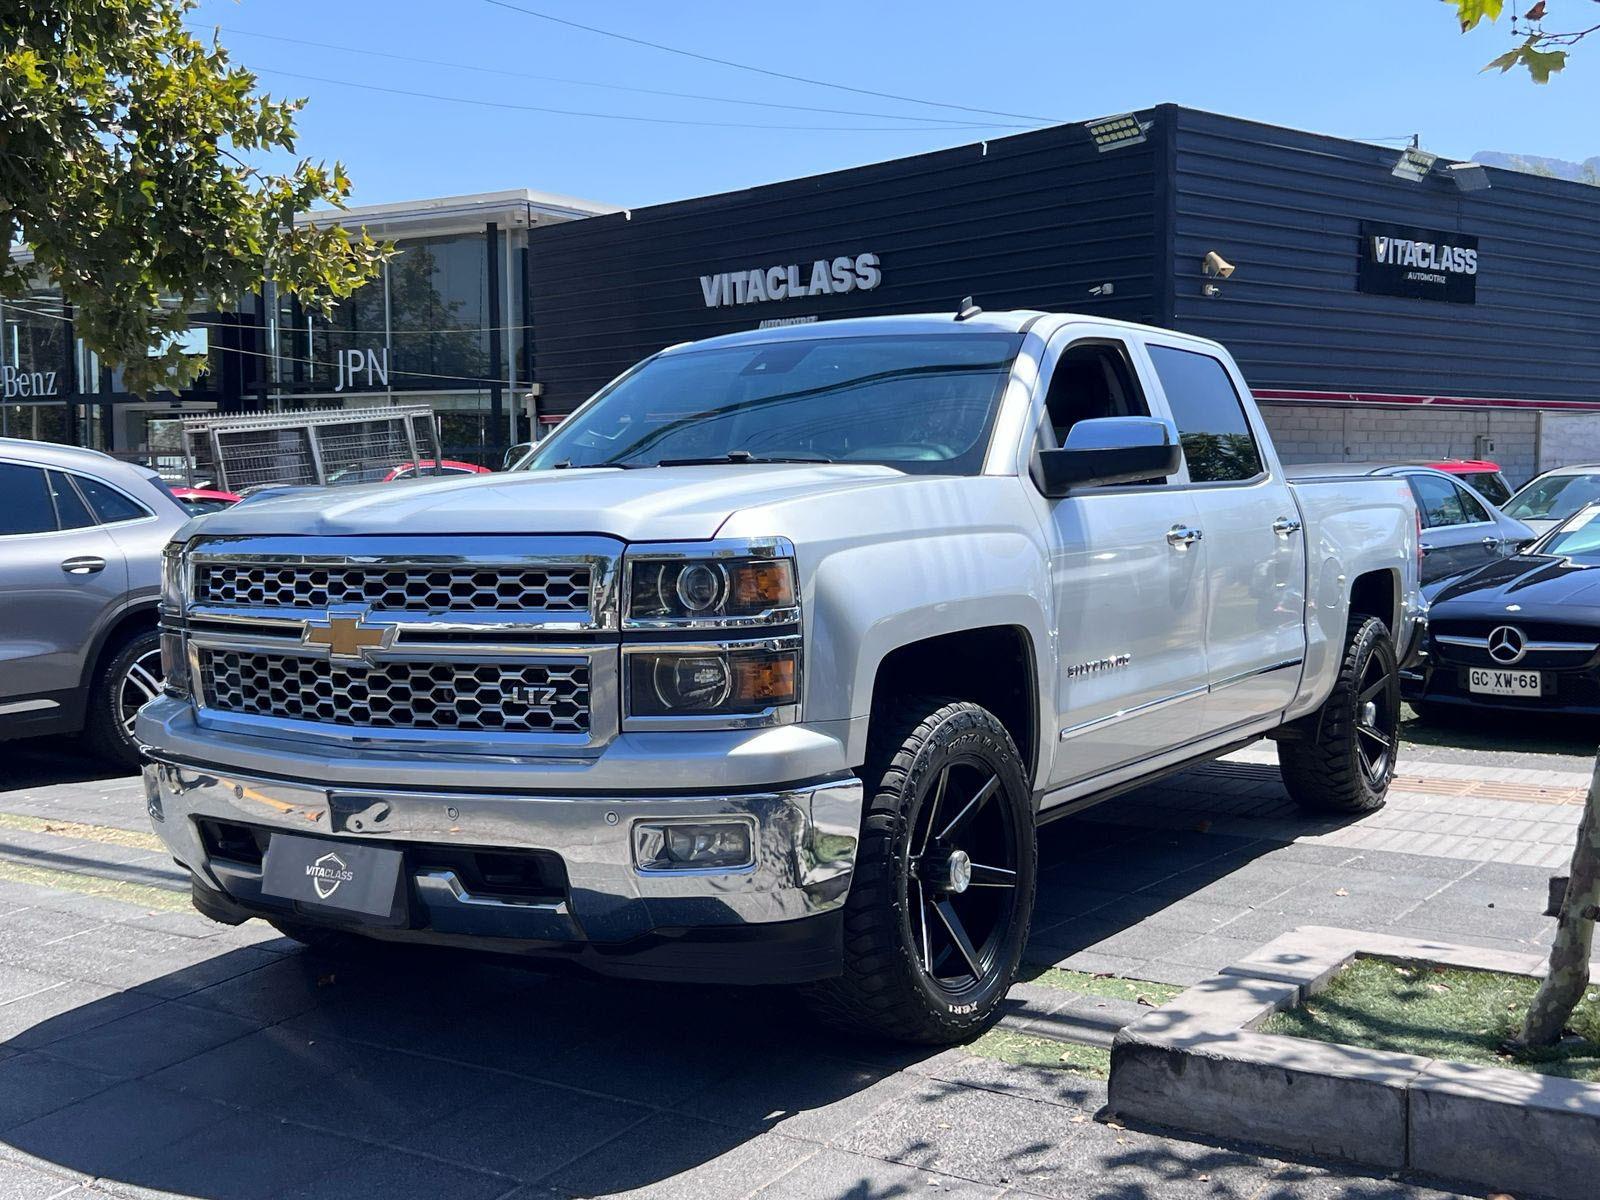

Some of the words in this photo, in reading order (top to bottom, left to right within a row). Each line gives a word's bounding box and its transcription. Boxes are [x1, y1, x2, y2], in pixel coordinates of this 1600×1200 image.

[1374, 236, 1478, 275] VITACLASS
[700, 252, 882, 308] VITACLASS
[1407, 272, 1446, 284] AUTOMOTRIZ
[335, 348, 388, 391] JPN
[512, 686, 557, 705] LTZ
[305, 865, 354, 881] VITACLASS
